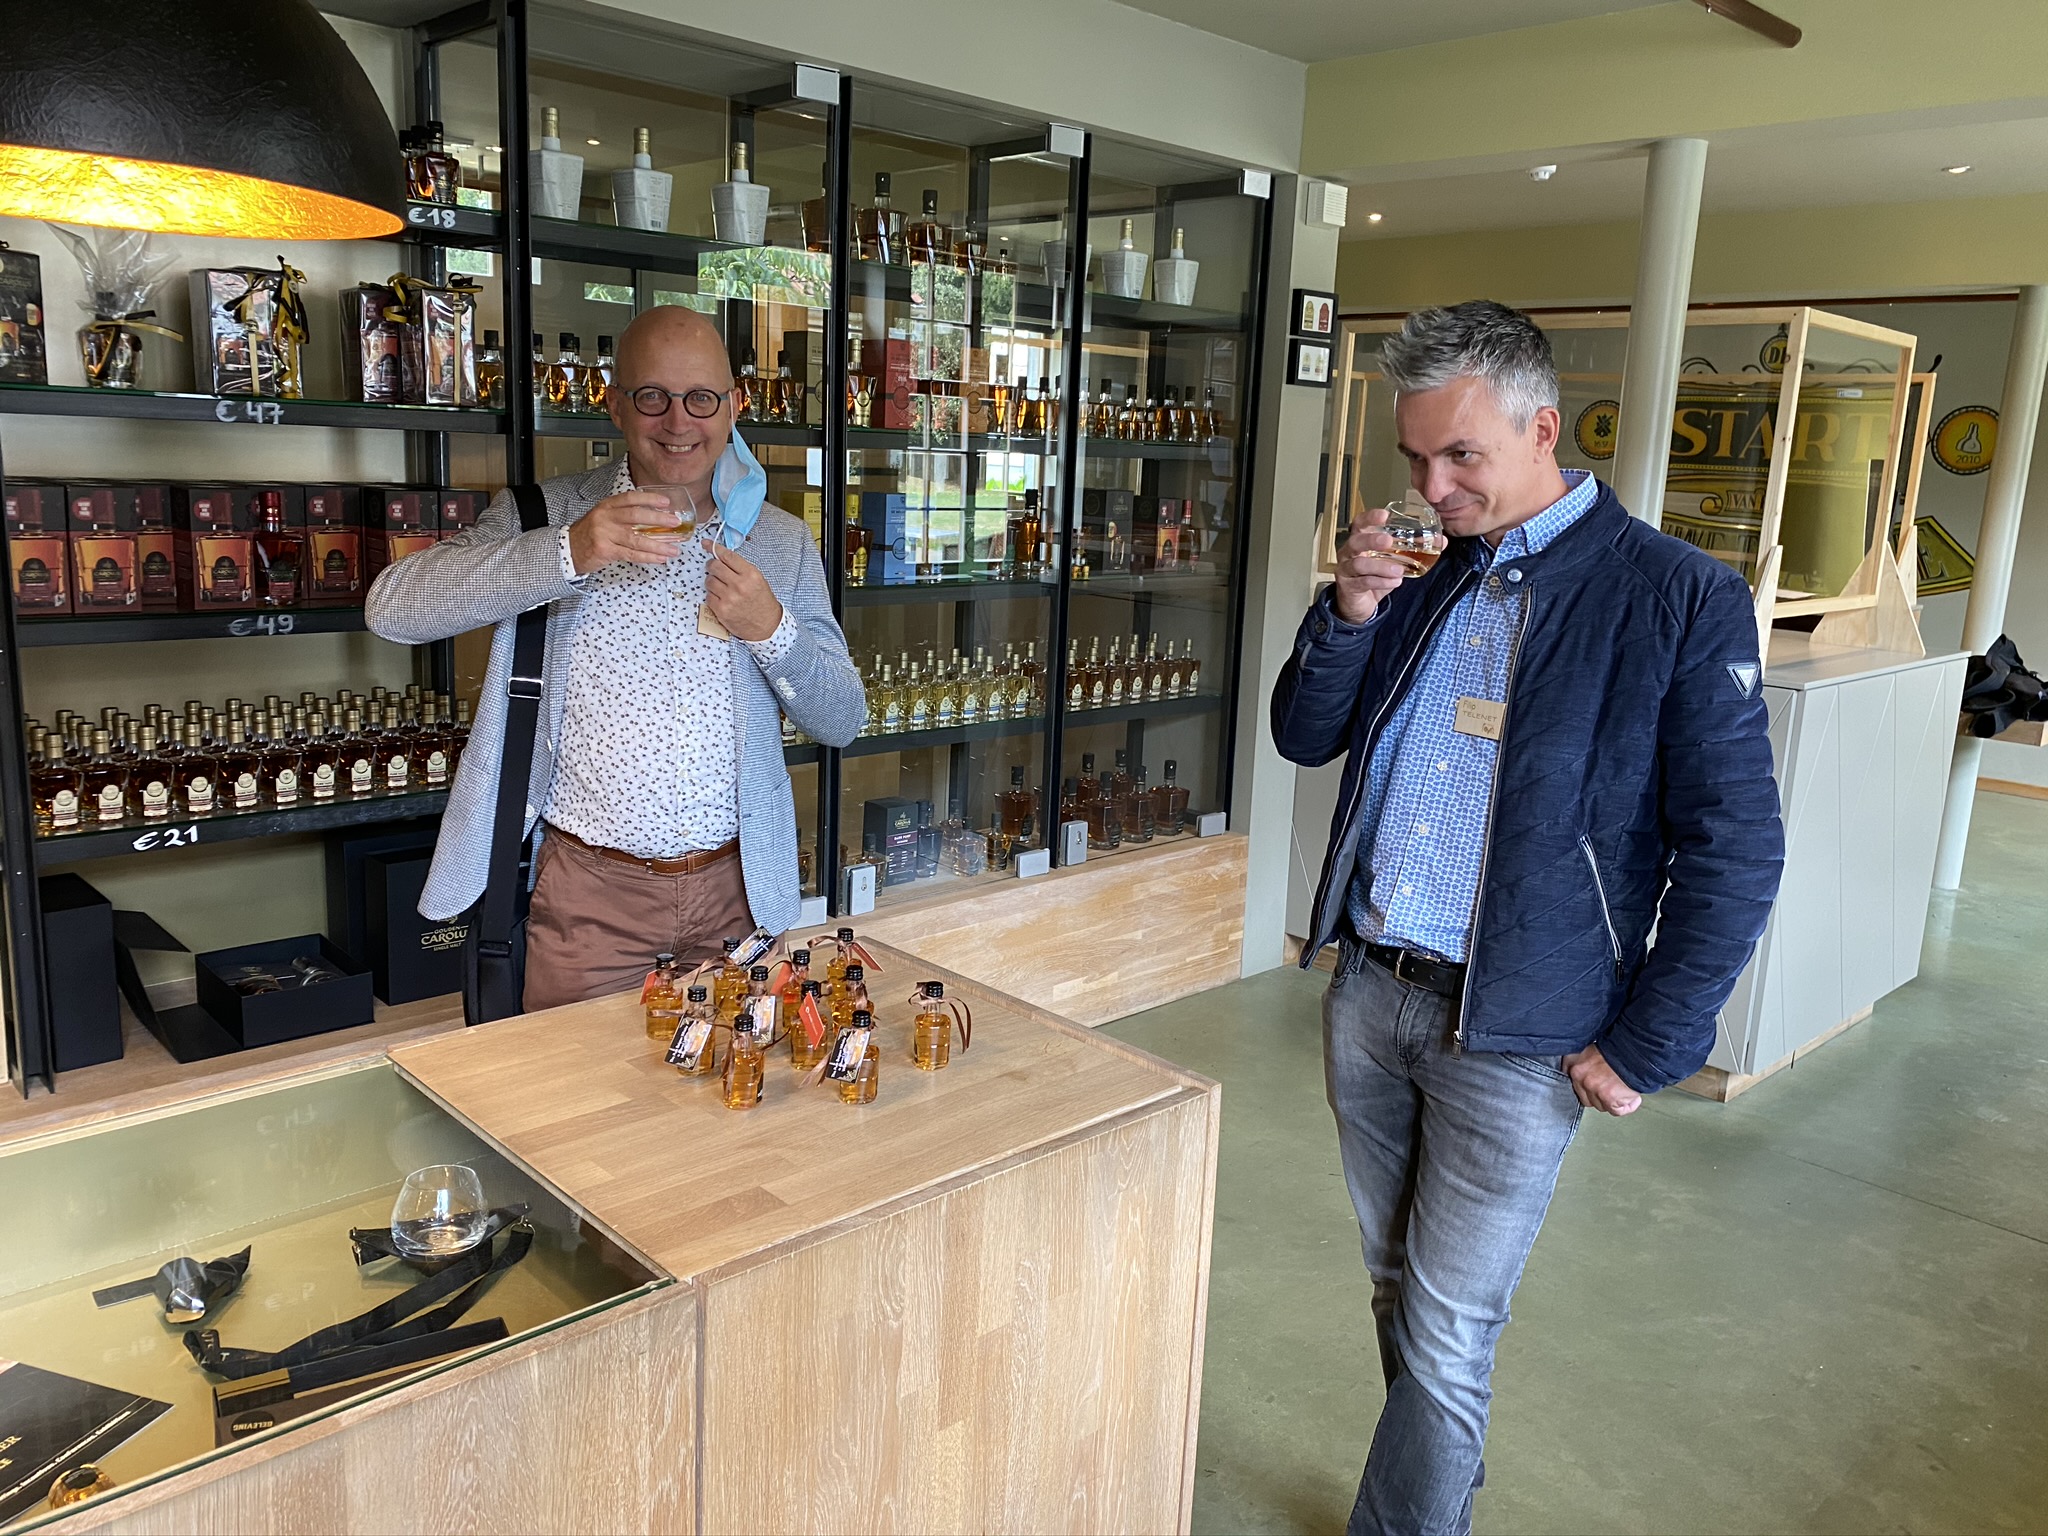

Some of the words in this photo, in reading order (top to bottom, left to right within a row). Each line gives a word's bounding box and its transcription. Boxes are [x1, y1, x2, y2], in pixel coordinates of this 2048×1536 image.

[408, 207, 457, 229] €18
[1956, 454, 1981, 465] 2010
[1462, 710, 1498, 723] TELENET
[132, 825, 199, 851] €21
[421, 929, 468, 945] CAROLU
[0, 1436, 22, 1452] ER
